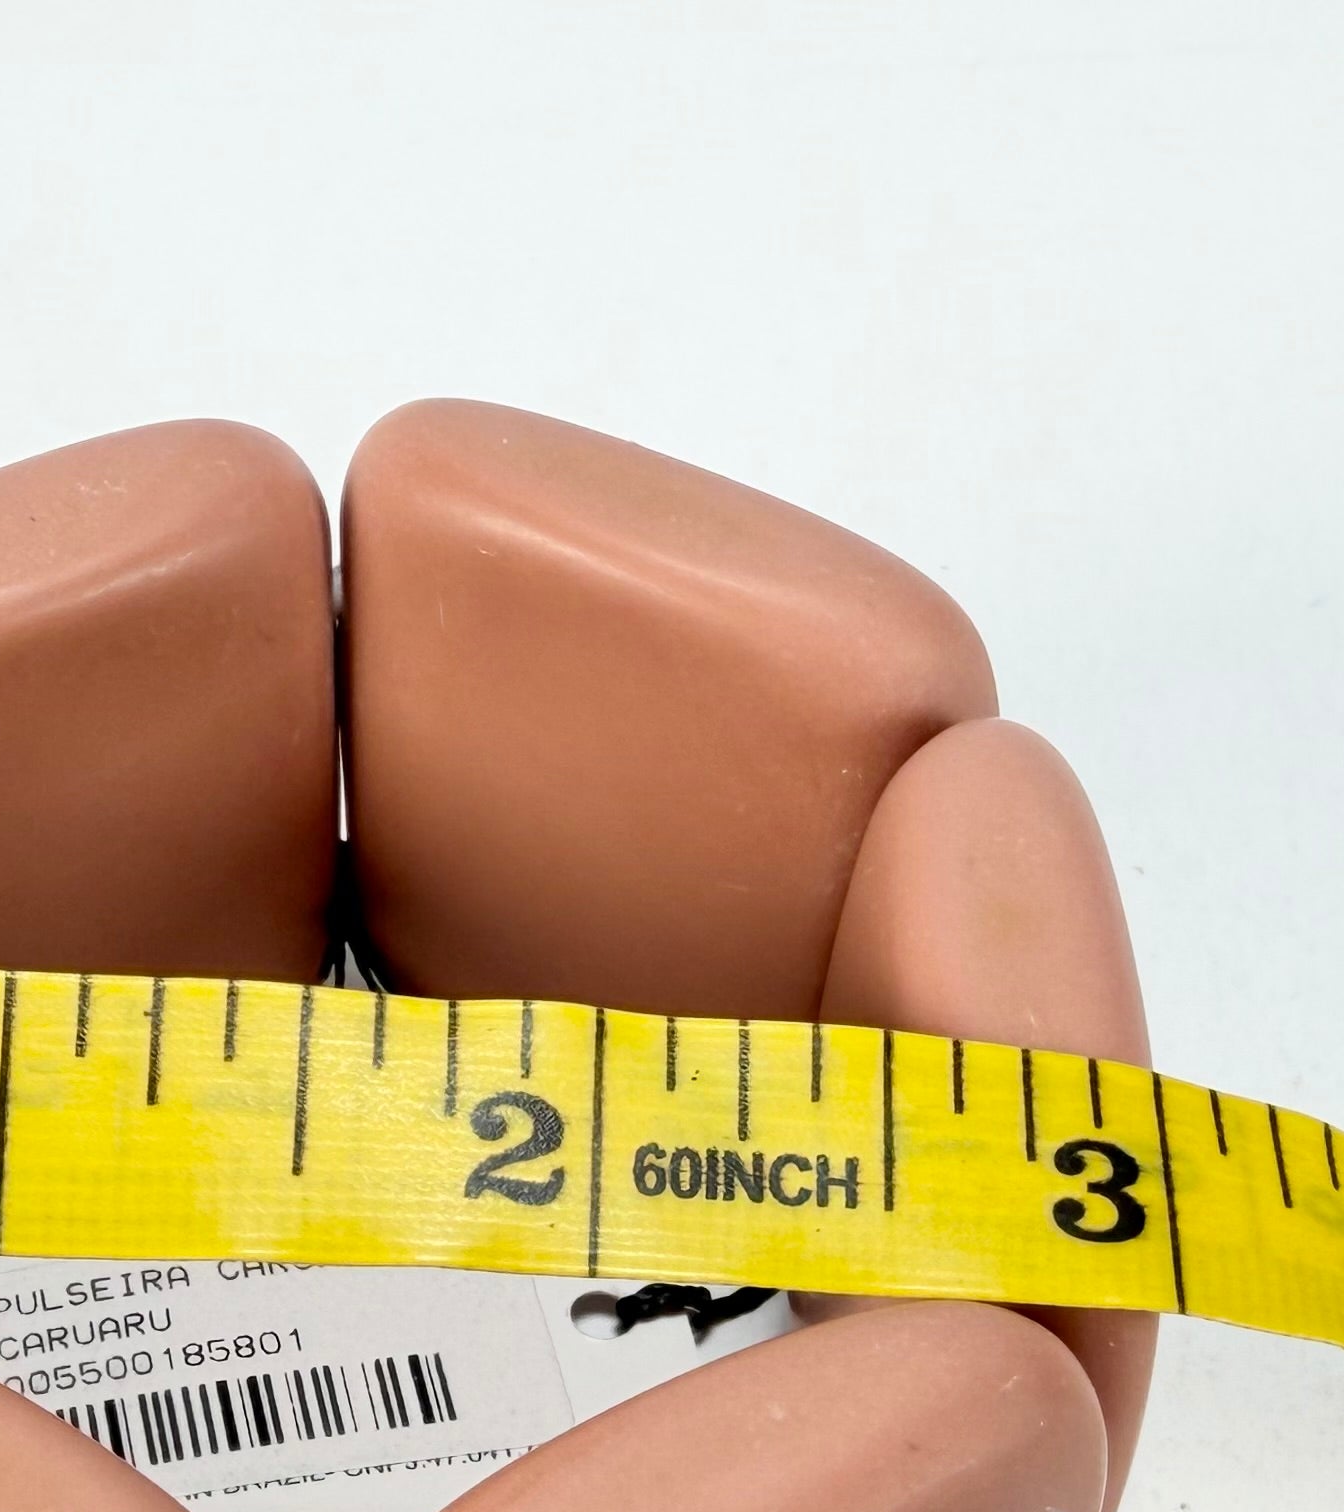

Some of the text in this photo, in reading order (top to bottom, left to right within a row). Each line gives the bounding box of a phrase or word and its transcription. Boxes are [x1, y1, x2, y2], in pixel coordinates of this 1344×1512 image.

[464, 1090, 565, 1206] 2
[631, 1143, 861, 1210] 60INCH
[1052, 1138, 1148, 1244] 3
[3, 1328, 303, 1396] 005500185801
